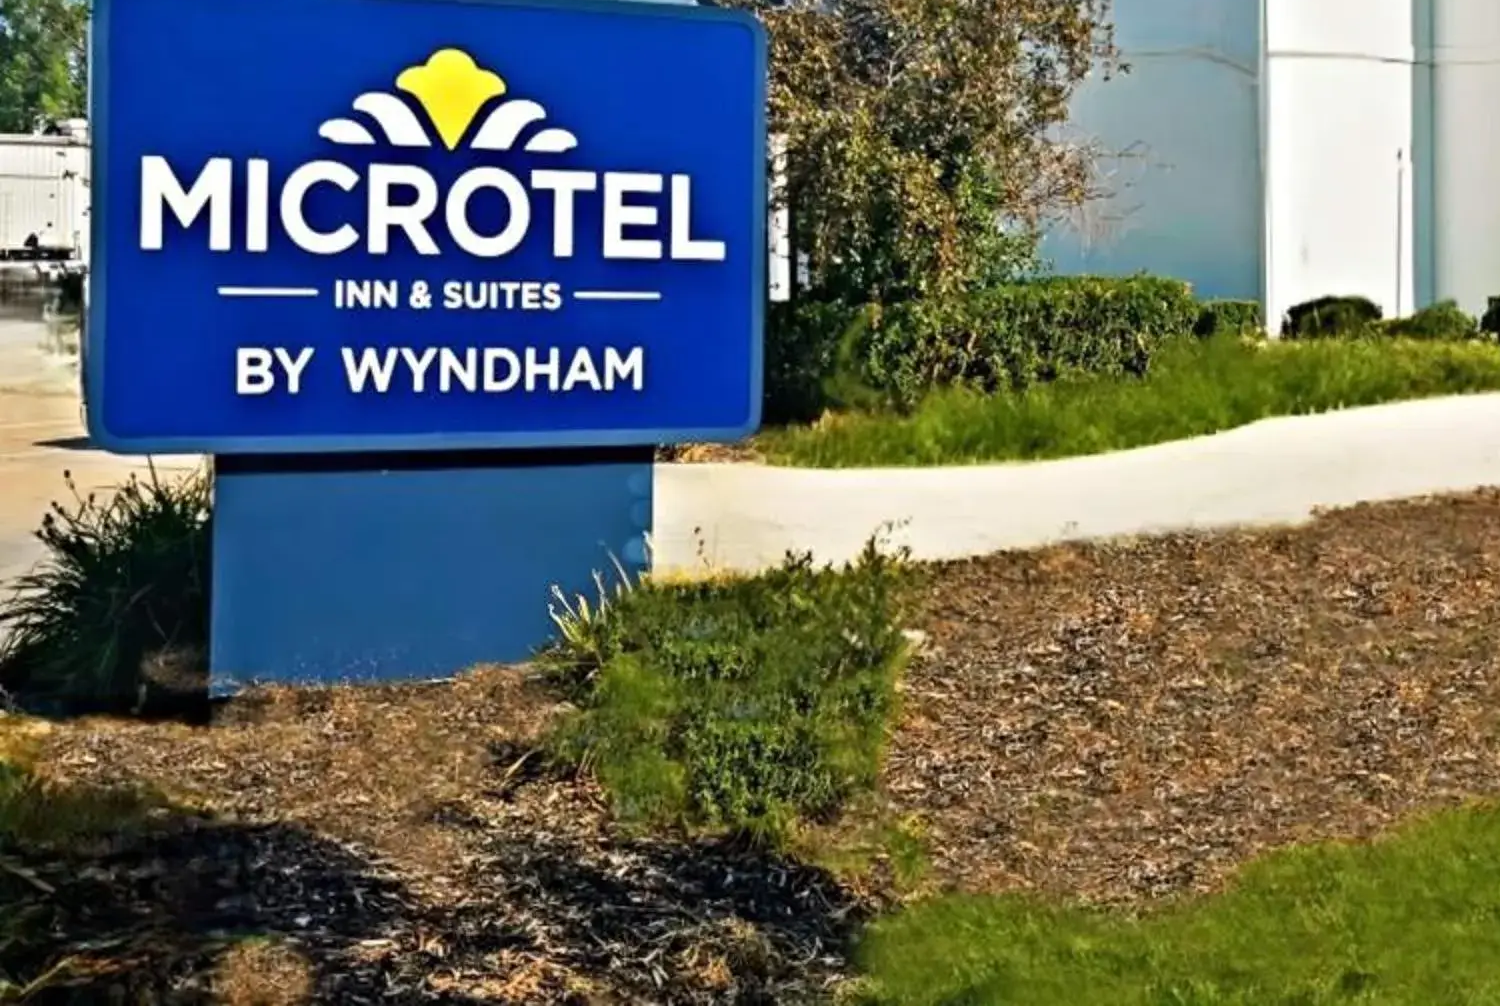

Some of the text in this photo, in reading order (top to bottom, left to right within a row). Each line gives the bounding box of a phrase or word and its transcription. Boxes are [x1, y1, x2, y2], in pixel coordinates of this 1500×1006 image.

[140, 154, 726, 261] MICROTEL
[335, 280, 562, 310] INN & SUITES
[236, 347, 643, 395] BY WYNDHAM
